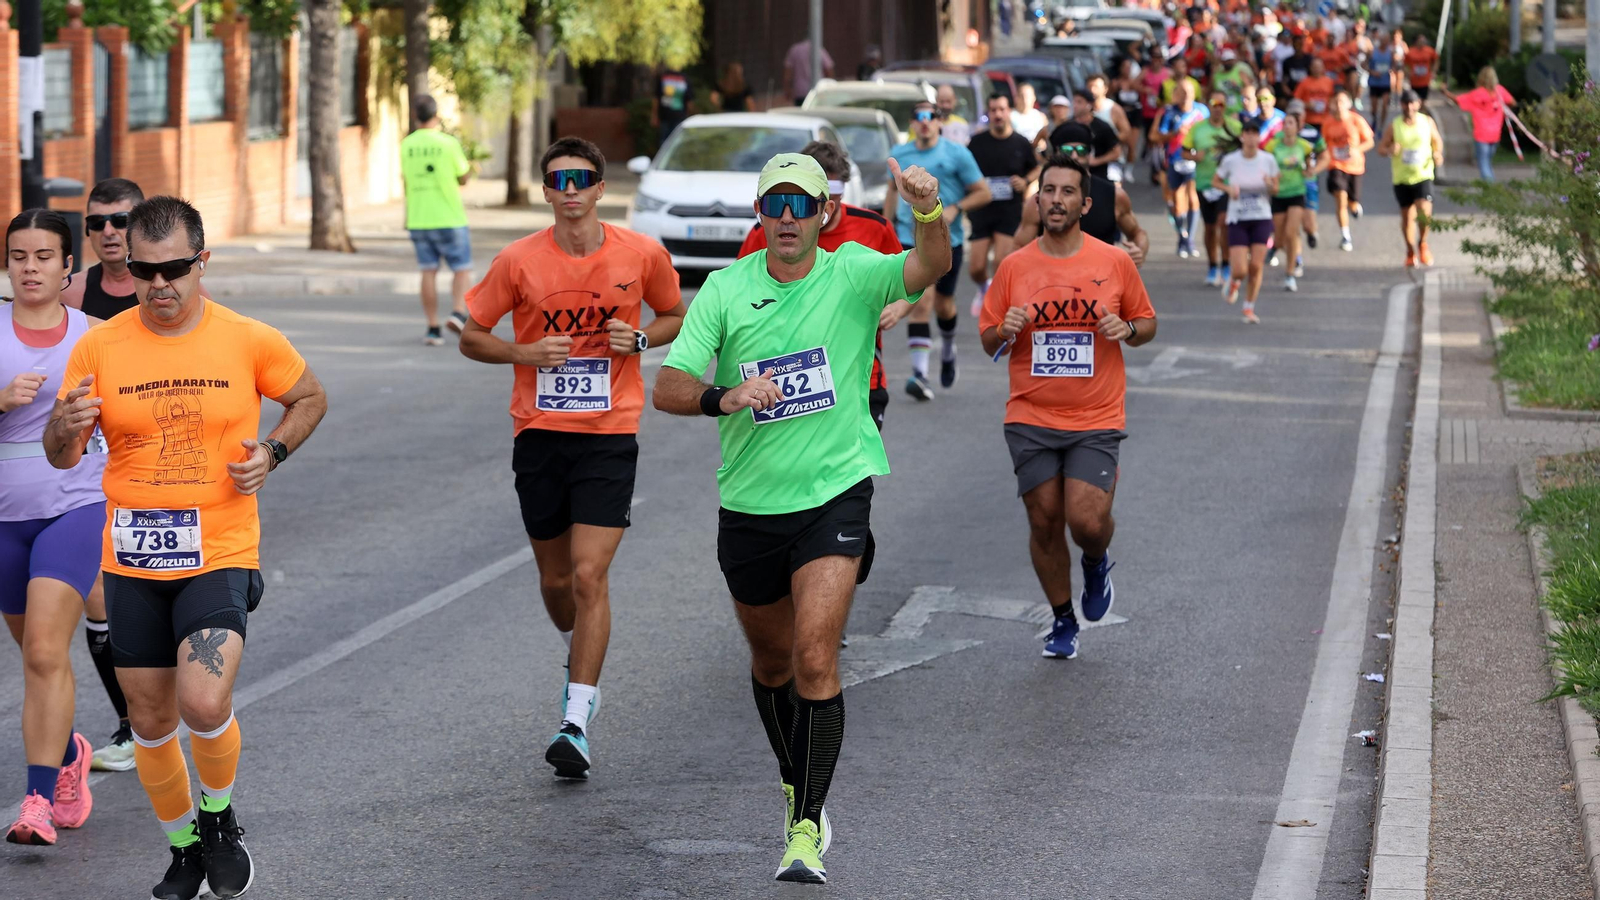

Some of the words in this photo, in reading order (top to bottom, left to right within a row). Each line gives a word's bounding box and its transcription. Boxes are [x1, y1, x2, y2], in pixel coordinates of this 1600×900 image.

[1047, 347, 1077, 361] 890
[1054, 366, 1089, 374] MIZUNO
[119, 386, 134, 395] VIII
[135, 380, 170, 393] MEDIA
[171, 378, 229, 389] MARATÓN
[164, 387, 188, 396] PUERTO
[189, 388, 204, 396] REAL
[555, 376, 592, 394] 893
[771, 373, 812, 397] 62
[562, 399, 605, 409] MIZUNO
[782, 397, 831, 416] MIZUNO
[132, 530, 178, 551] 738
[146, 557, 196, 568] MIZUNO
